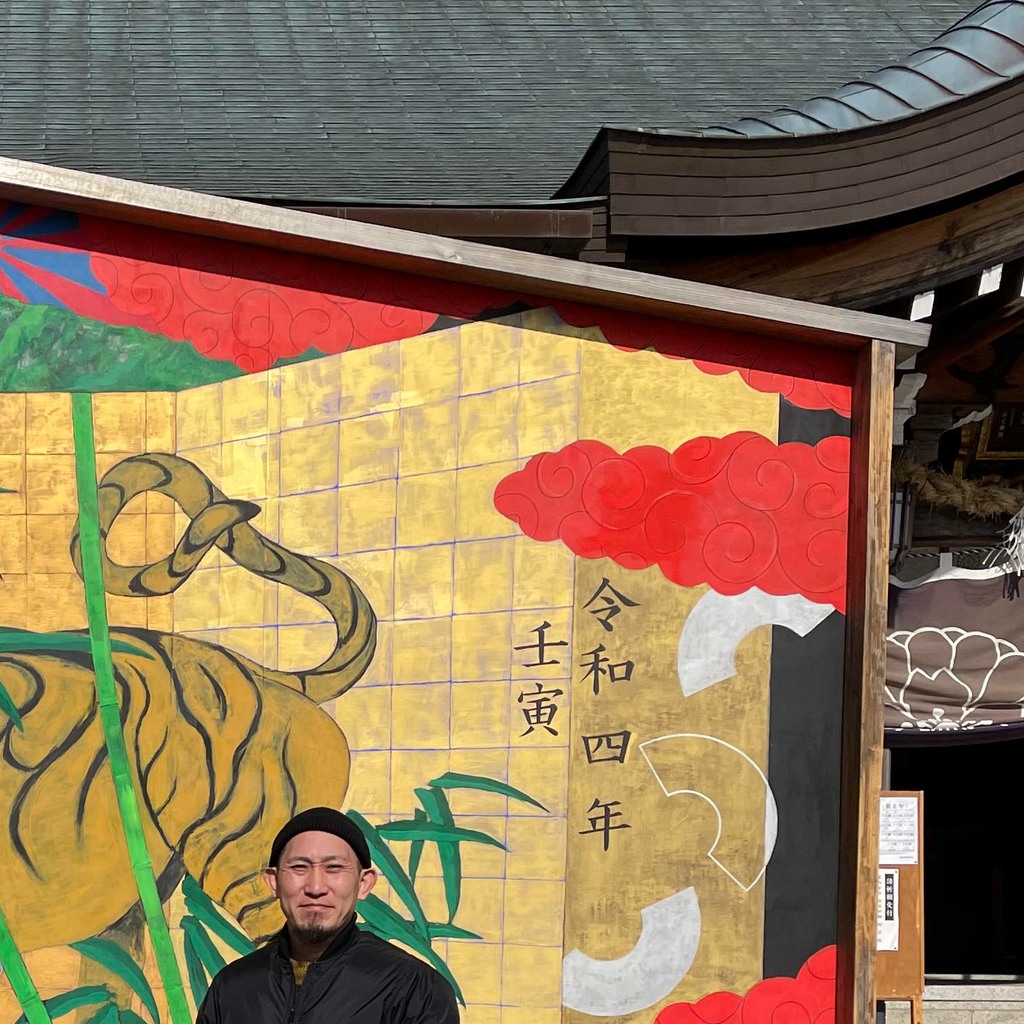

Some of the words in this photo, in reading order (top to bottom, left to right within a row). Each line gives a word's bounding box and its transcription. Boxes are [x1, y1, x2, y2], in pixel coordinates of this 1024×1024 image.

[513, 620, 569, 738] 壬寅
[578, 577, 642, 851] 令和四年
